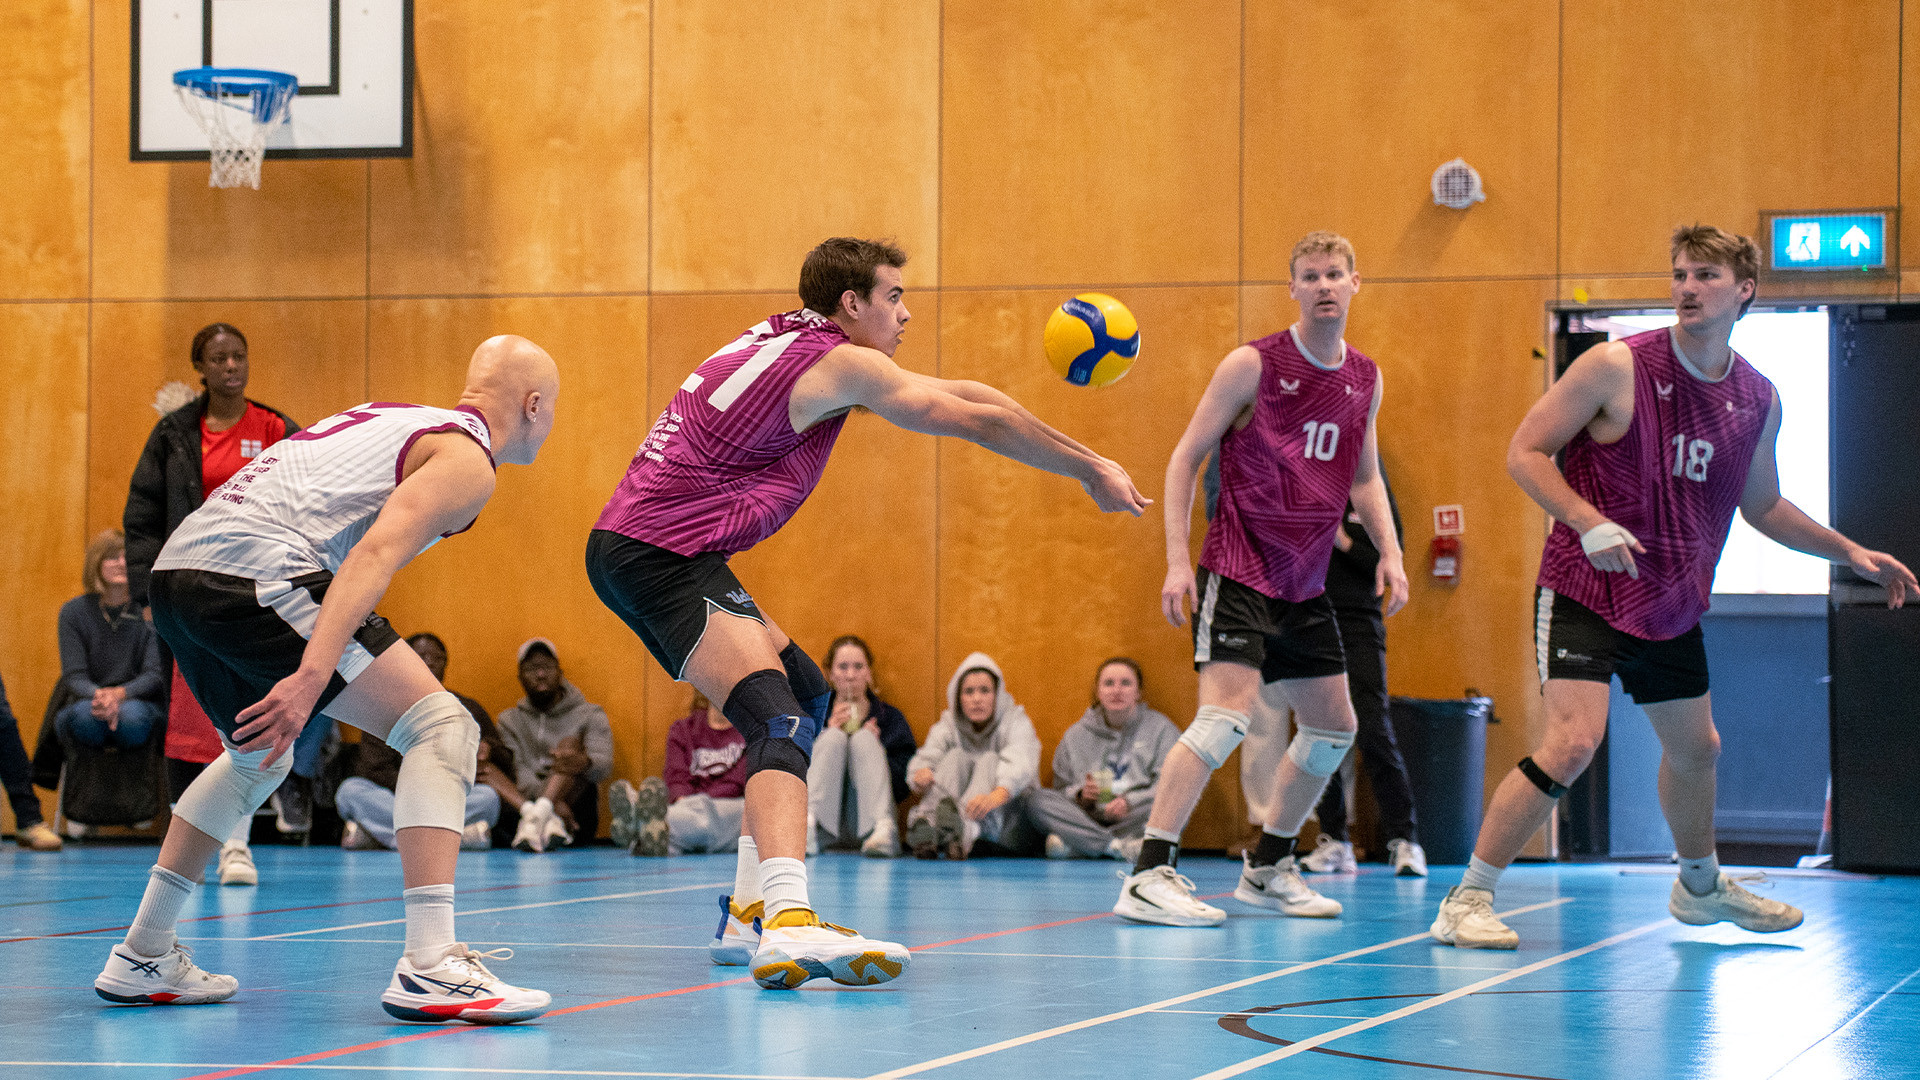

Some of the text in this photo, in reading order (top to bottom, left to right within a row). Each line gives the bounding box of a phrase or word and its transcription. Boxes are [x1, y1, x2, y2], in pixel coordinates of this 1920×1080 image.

[1303, 420, 1340, 461] 10
[1672, 433, 1714, 482] 18
[240, 473, 256, 483] THE
[220, 493, 244, 505] FLYING
